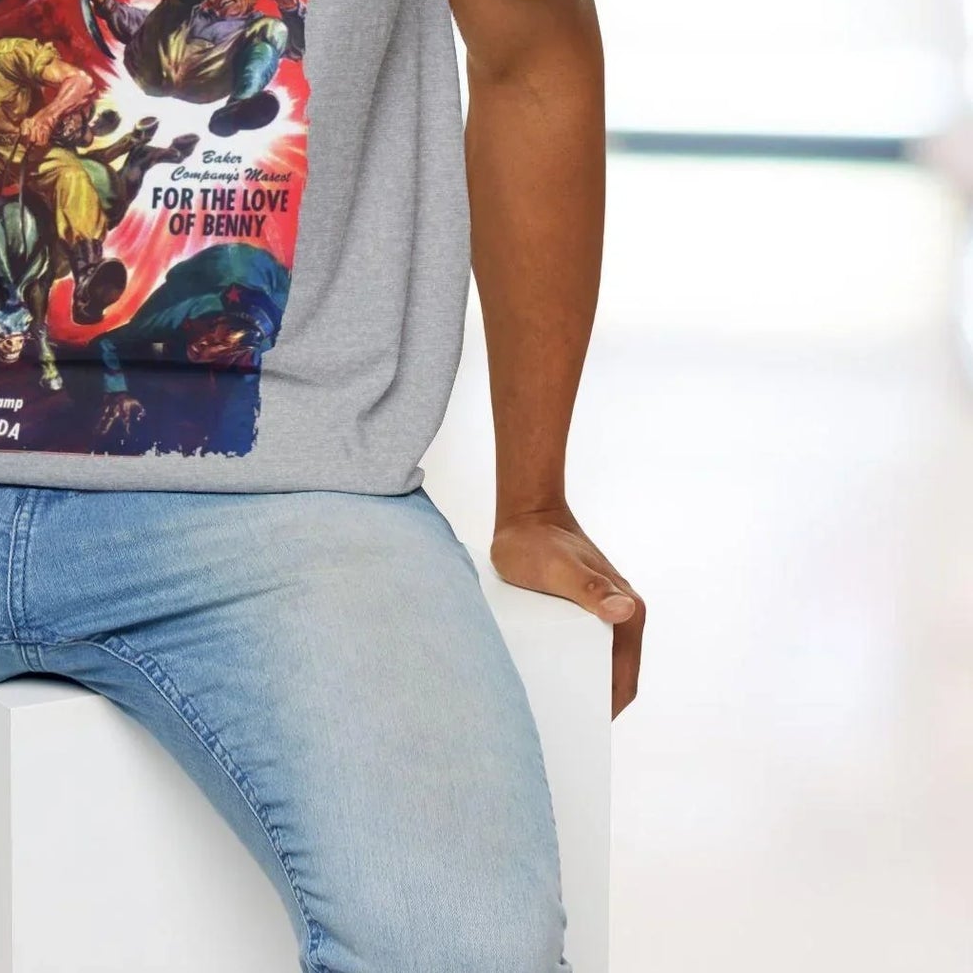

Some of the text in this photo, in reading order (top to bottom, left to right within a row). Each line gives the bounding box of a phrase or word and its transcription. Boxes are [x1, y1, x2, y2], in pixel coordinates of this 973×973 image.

[202, 149, 243, 165] Baker
[170, 165, 293, 184] Company's Mascot
[151, 186, 290, 213] FOR THE LOVE
[168, 213, 267, 238] OF BENNY
